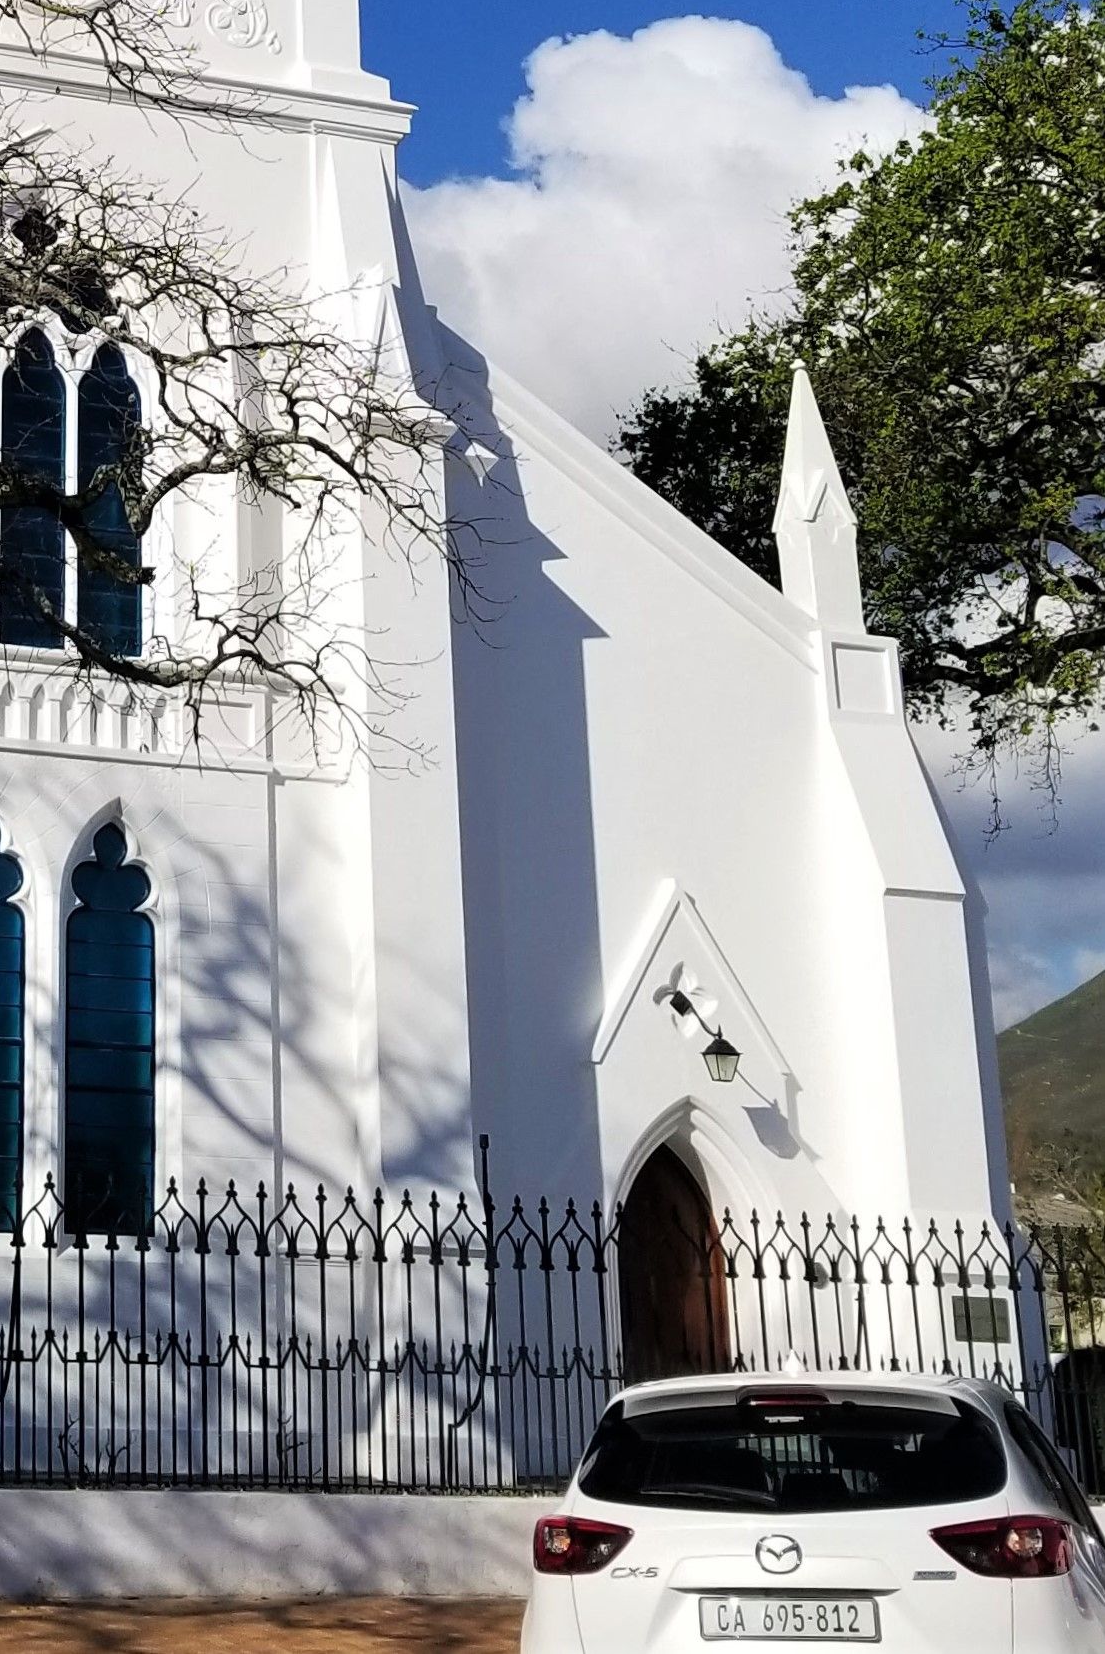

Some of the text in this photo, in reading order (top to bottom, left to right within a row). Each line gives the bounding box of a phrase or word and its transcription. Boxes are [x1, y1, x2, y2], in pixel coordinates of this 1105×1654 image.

[610, 1566, 660, 1578] CX-5
[717, 1603, 860, 1632] CA 695-812
